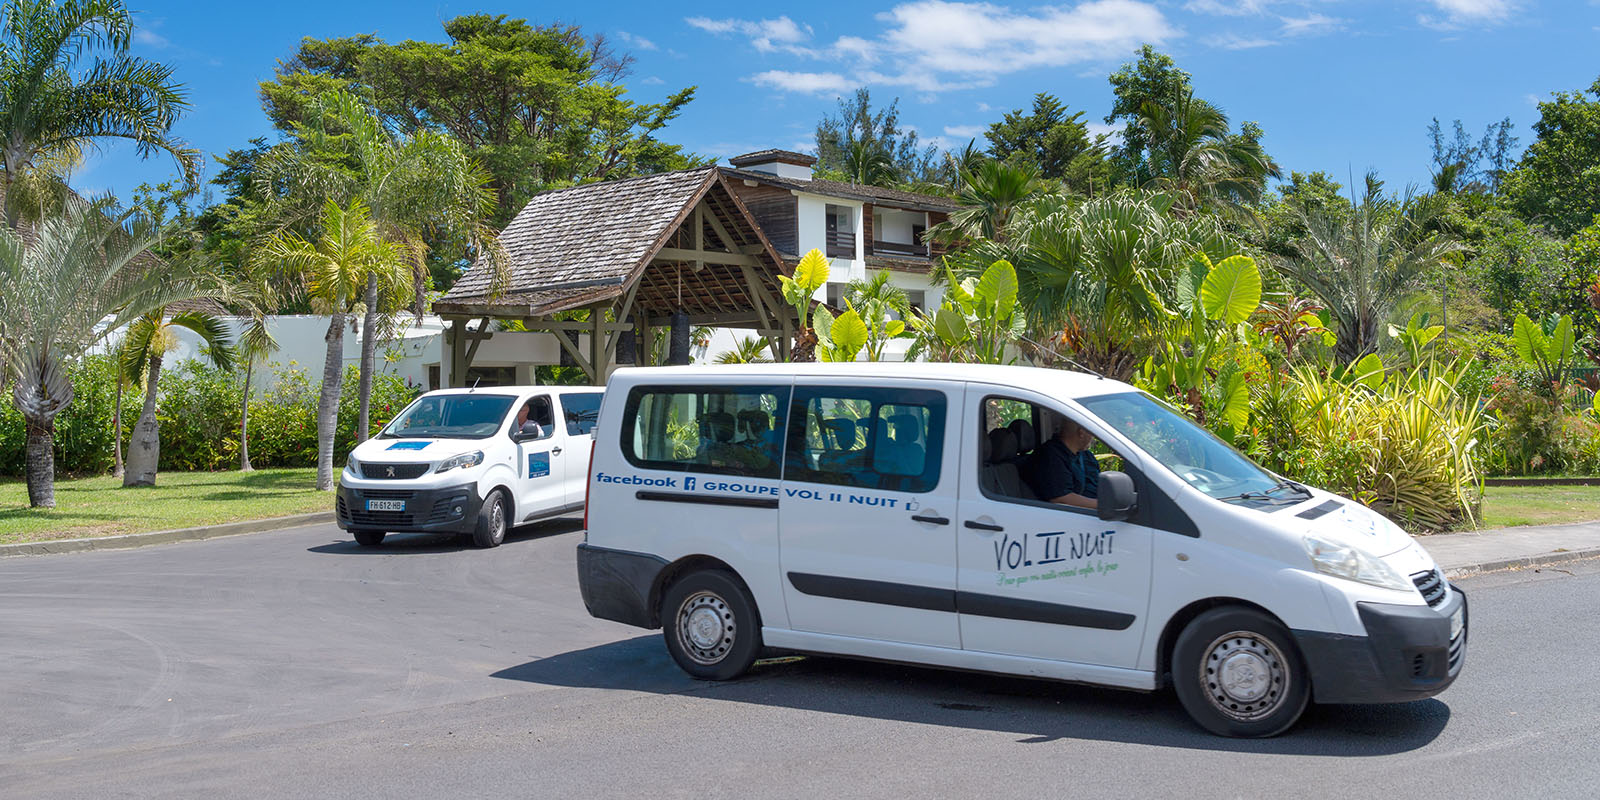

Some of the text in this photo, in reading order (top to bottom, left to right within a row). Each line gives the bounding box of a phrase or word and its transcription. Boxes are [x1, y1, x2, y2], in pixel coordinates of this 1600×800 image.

[596, 472, 676, 488] facebook
[703, 481, 779, 496] GROUPE
[785, 488, 823, 501] VOL
[849, 495, 898, 508] NUIT
[994, 533, 1032, 571] VOL
